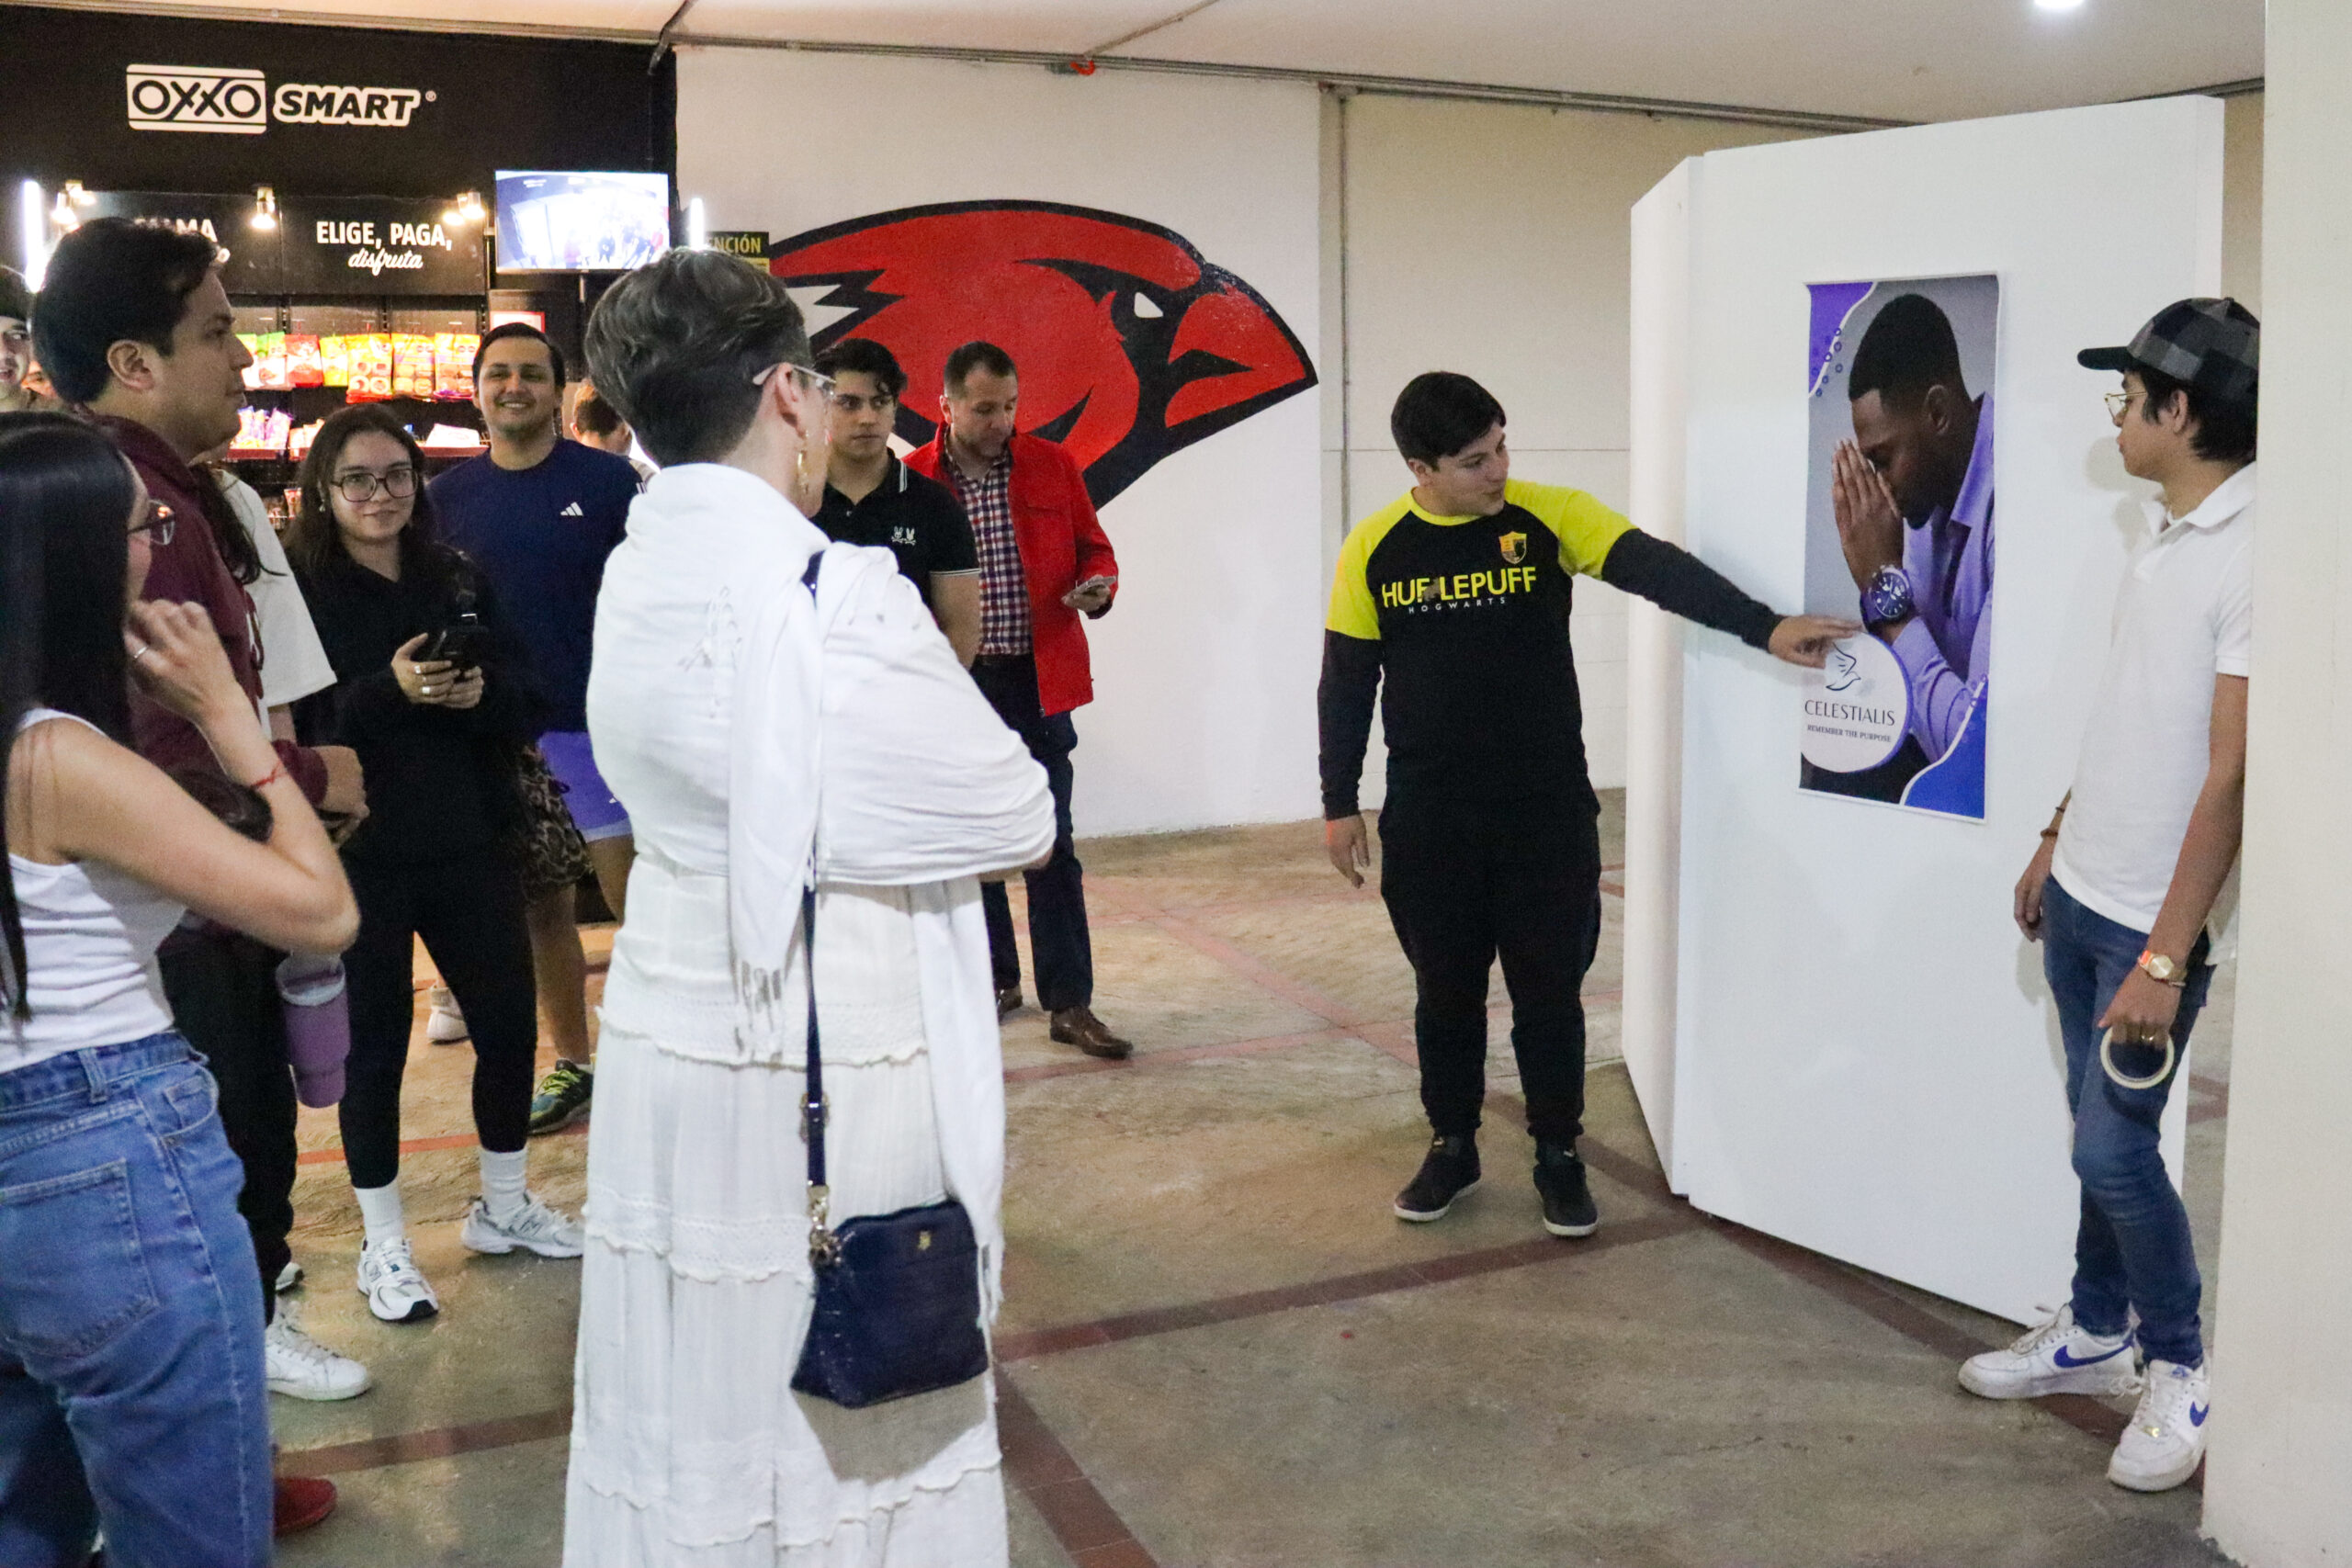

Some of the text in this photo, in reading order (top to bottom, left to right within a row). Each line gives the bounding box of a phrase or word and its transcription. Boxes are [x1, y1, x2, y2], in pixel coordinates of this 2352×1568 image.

[132, 78, 414, 121] OXXO SMART
[316, 220, 453, 251] ELIGE, PAGA,
[707, 234, 761, 254] NCIÓN
[347, 247, 424, 276] disfruta
[1382, 566, 1537, 608] HUFLEPUFF
[1408, 596, 1506, 615] HOGWARTS
[1804, 699, 1895, 727] CELESTIALIS
[1807, 724, 1891, 742] REMEMBER THE PURPOSE
